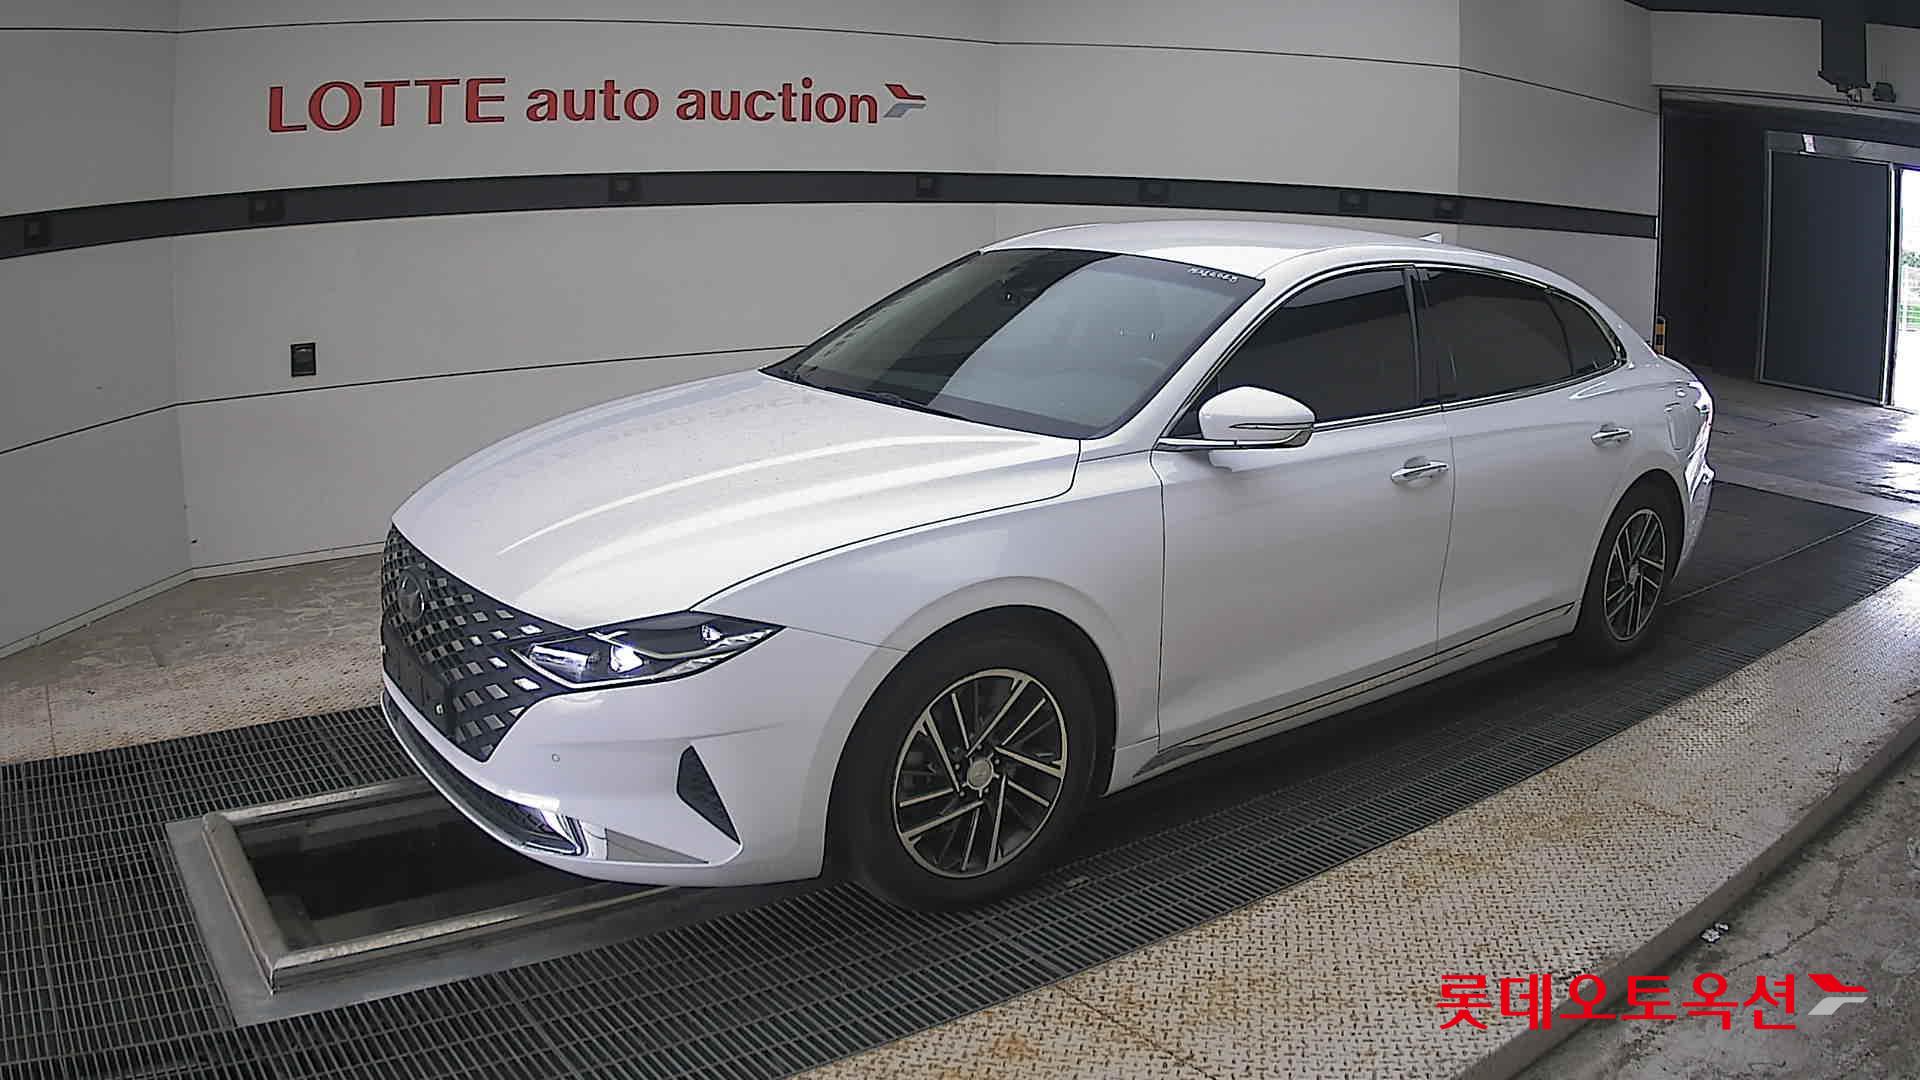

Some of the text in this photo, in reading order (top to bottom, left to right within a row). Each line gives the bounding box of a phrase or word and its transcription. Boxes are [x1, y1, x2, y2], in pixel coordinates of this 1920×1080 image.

[268, 76, 879, 133] LOTTE auto auction
